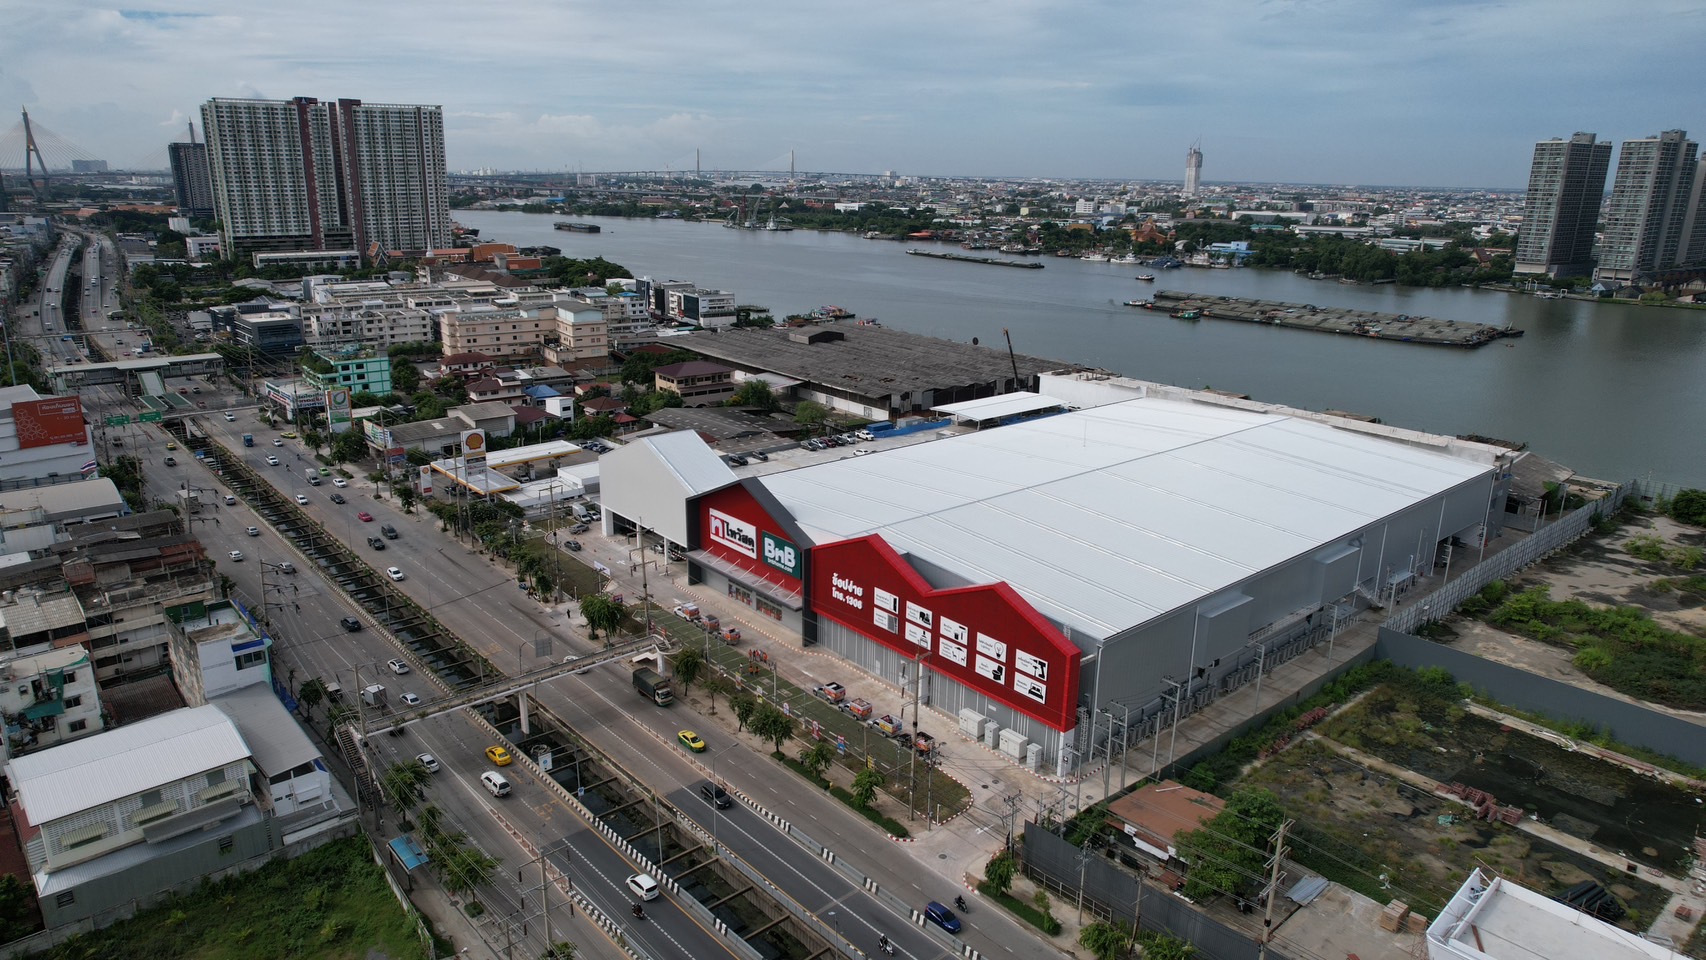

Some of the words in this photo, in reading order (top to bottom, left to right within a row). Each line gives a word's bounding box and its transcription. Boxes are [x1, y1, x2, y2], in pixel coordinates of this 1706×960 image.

[724, 521, 755, 553] ไทวัสดุ
[764, 537, 796, 568] BnB
